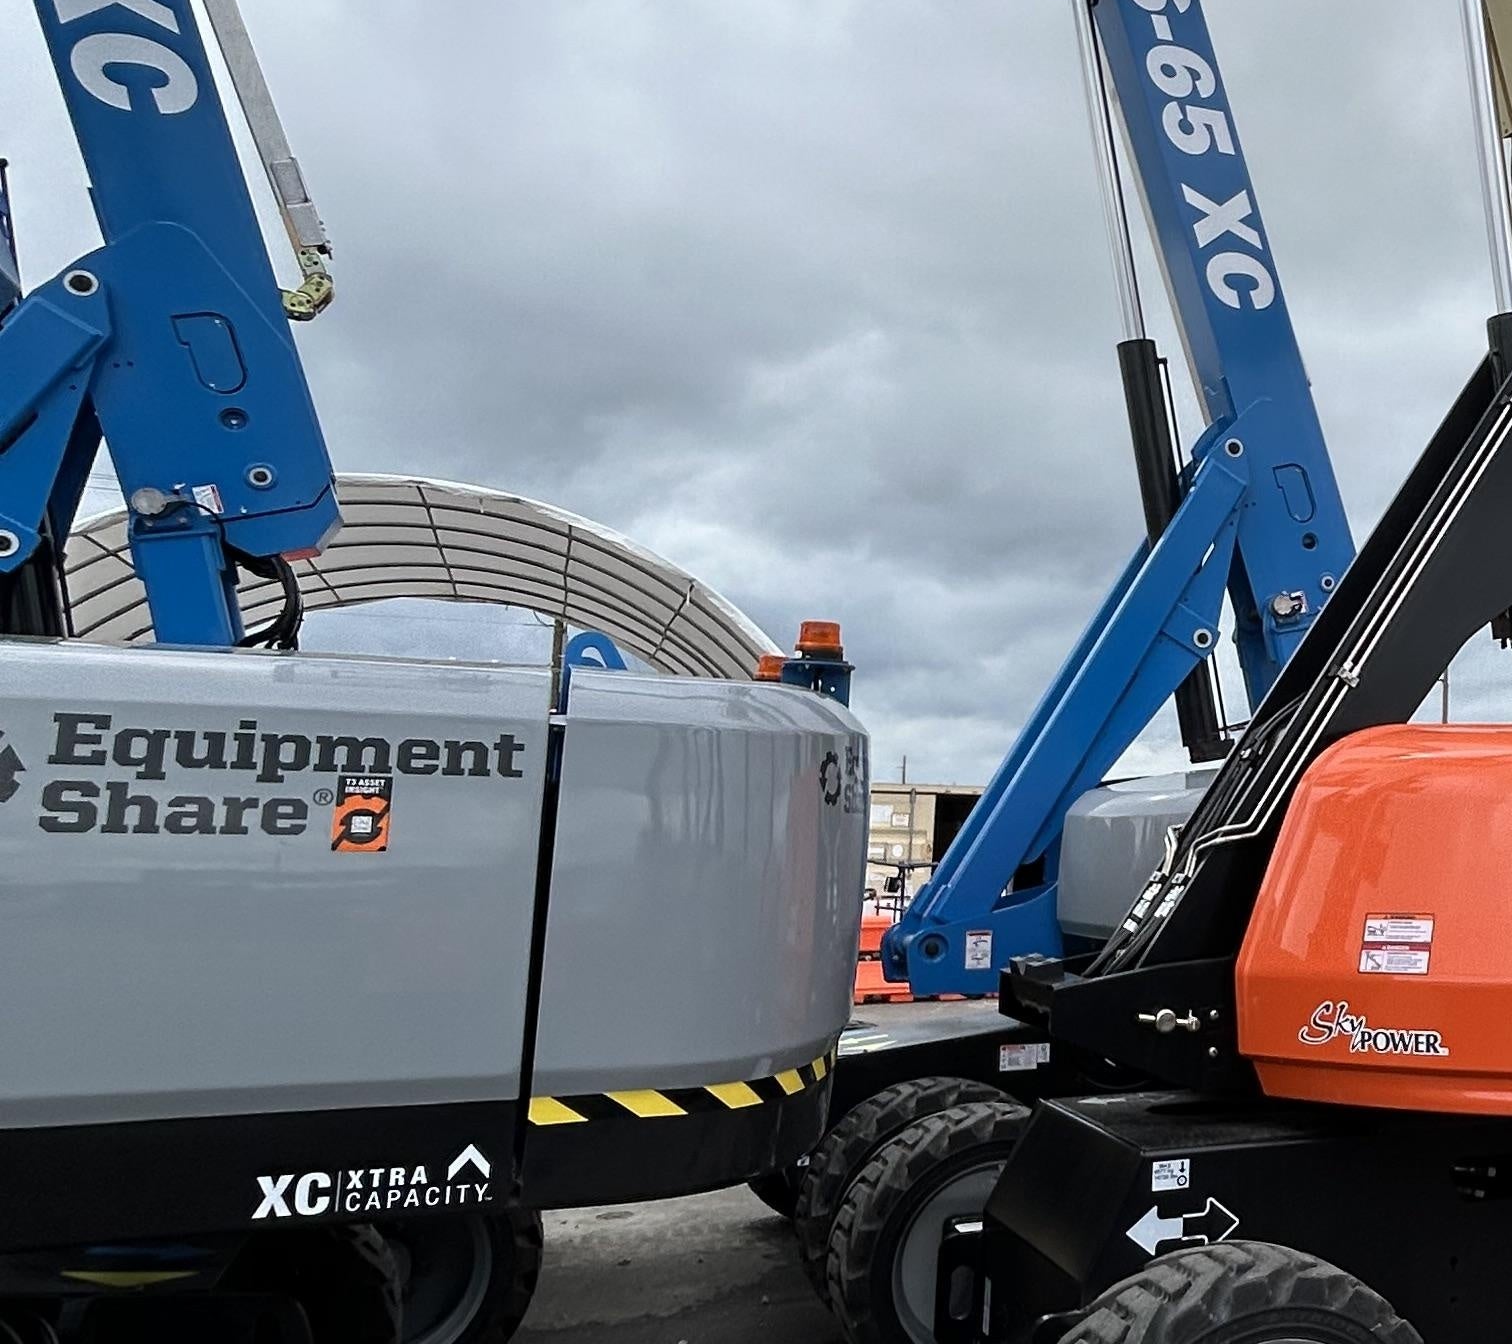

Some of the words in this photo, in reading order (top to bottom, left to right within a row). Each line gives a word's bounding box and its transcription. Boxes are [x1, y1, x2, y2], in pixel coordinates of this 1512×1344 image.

[1180, 183, 1276, 311] XC
[48, 712, 526, 782] Equipment
[37, 780, 308, 838] Share
[251, 1171, 332, 1220] XC
[346, 1165, 428, 1190] XTRA
[345, 1183, 490, 1212] CAPACITY
